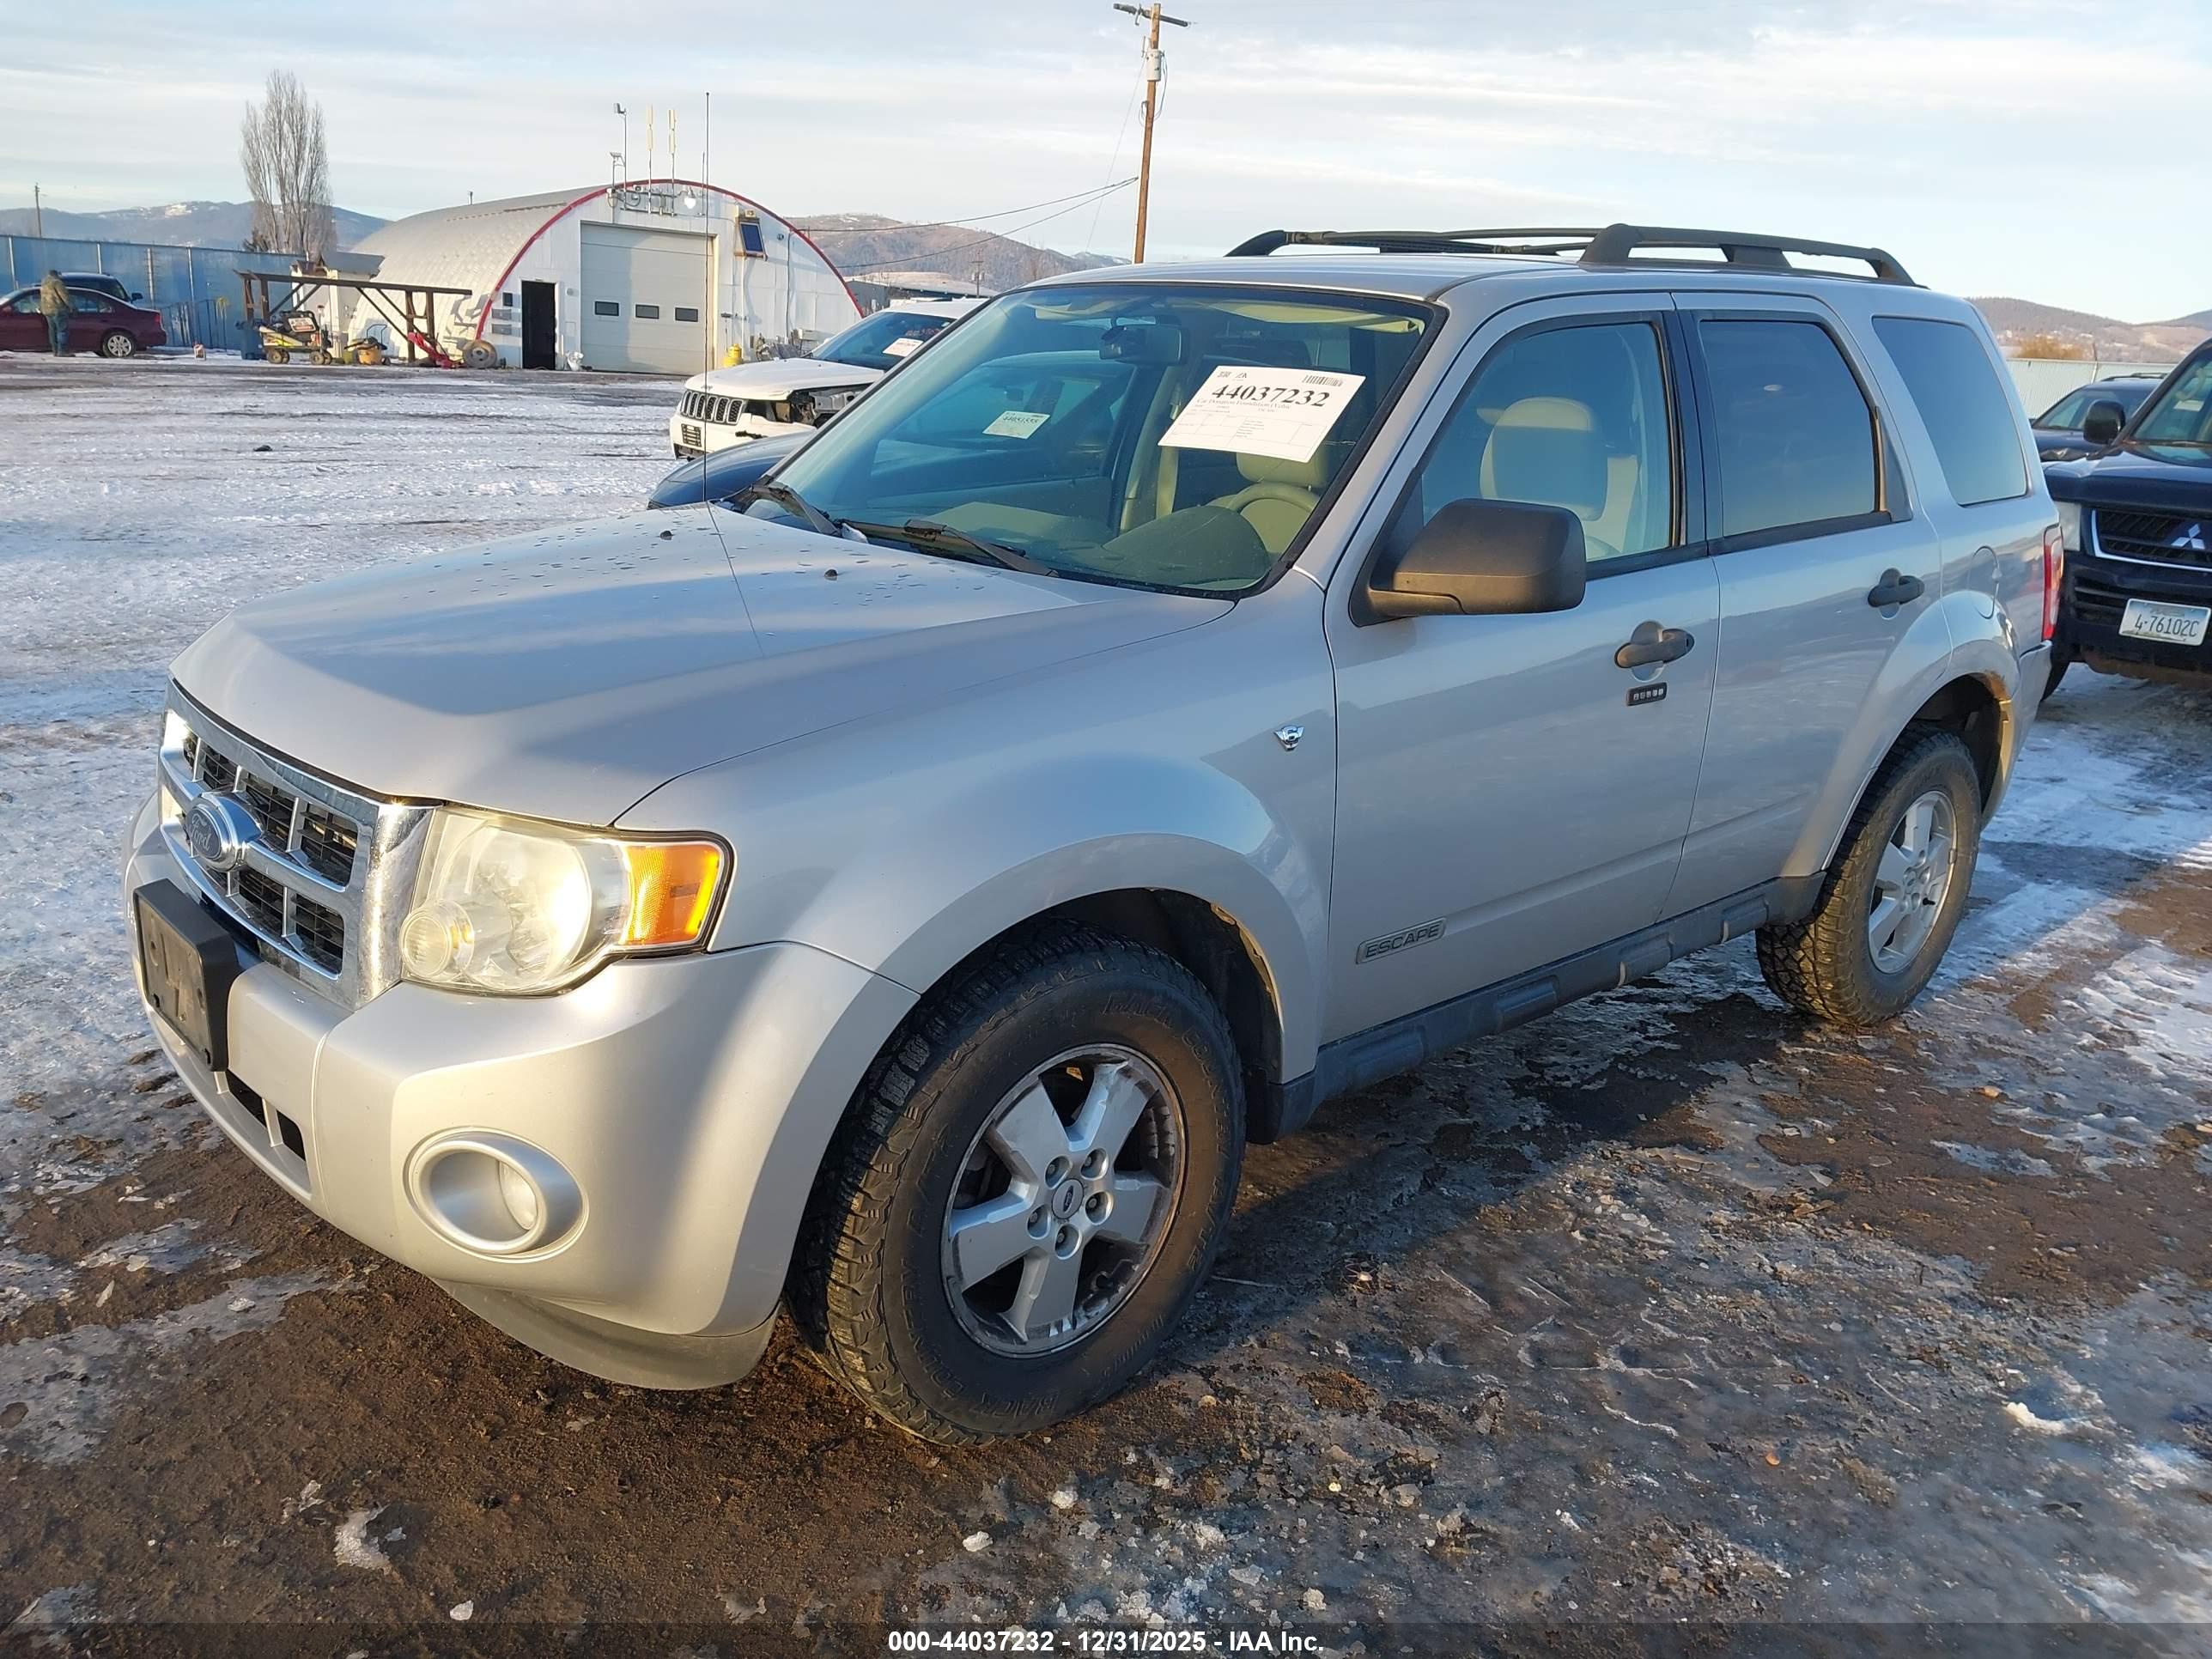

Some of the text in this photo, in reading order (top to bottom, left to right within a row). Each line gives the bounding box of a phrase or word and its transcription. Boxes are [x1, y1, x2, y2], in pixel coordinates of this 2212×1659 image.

[1212, 385, 1330, 407] 44037232
[191, 812, 212, 852] Ford
[1365, 924, 1440, 957] ESCAPE
